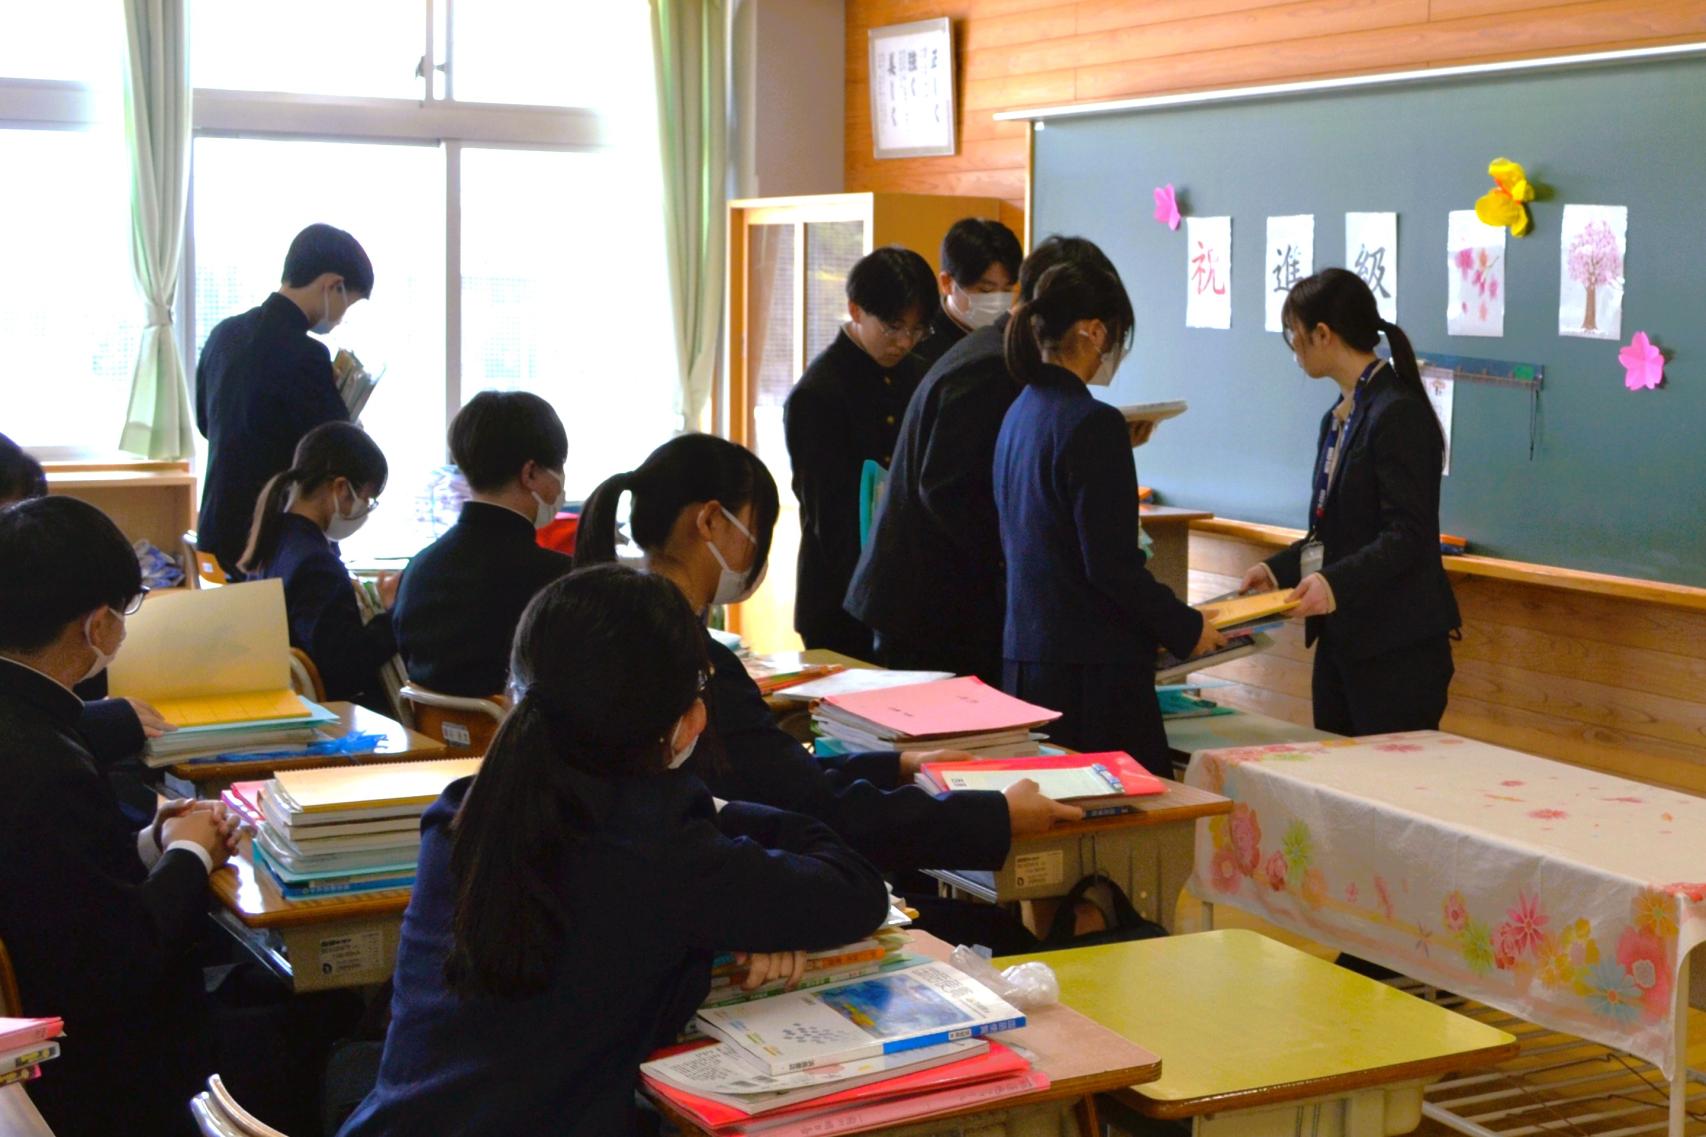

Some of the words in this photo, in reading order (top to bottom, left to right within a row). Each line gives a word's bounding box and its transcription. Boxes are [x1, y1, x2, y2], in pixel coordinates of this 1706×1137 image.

[1191, 240, 1226, 295] 祝
[1272, 244, 1305, 293] 進
[1354, 243, 1392, 299] 級
